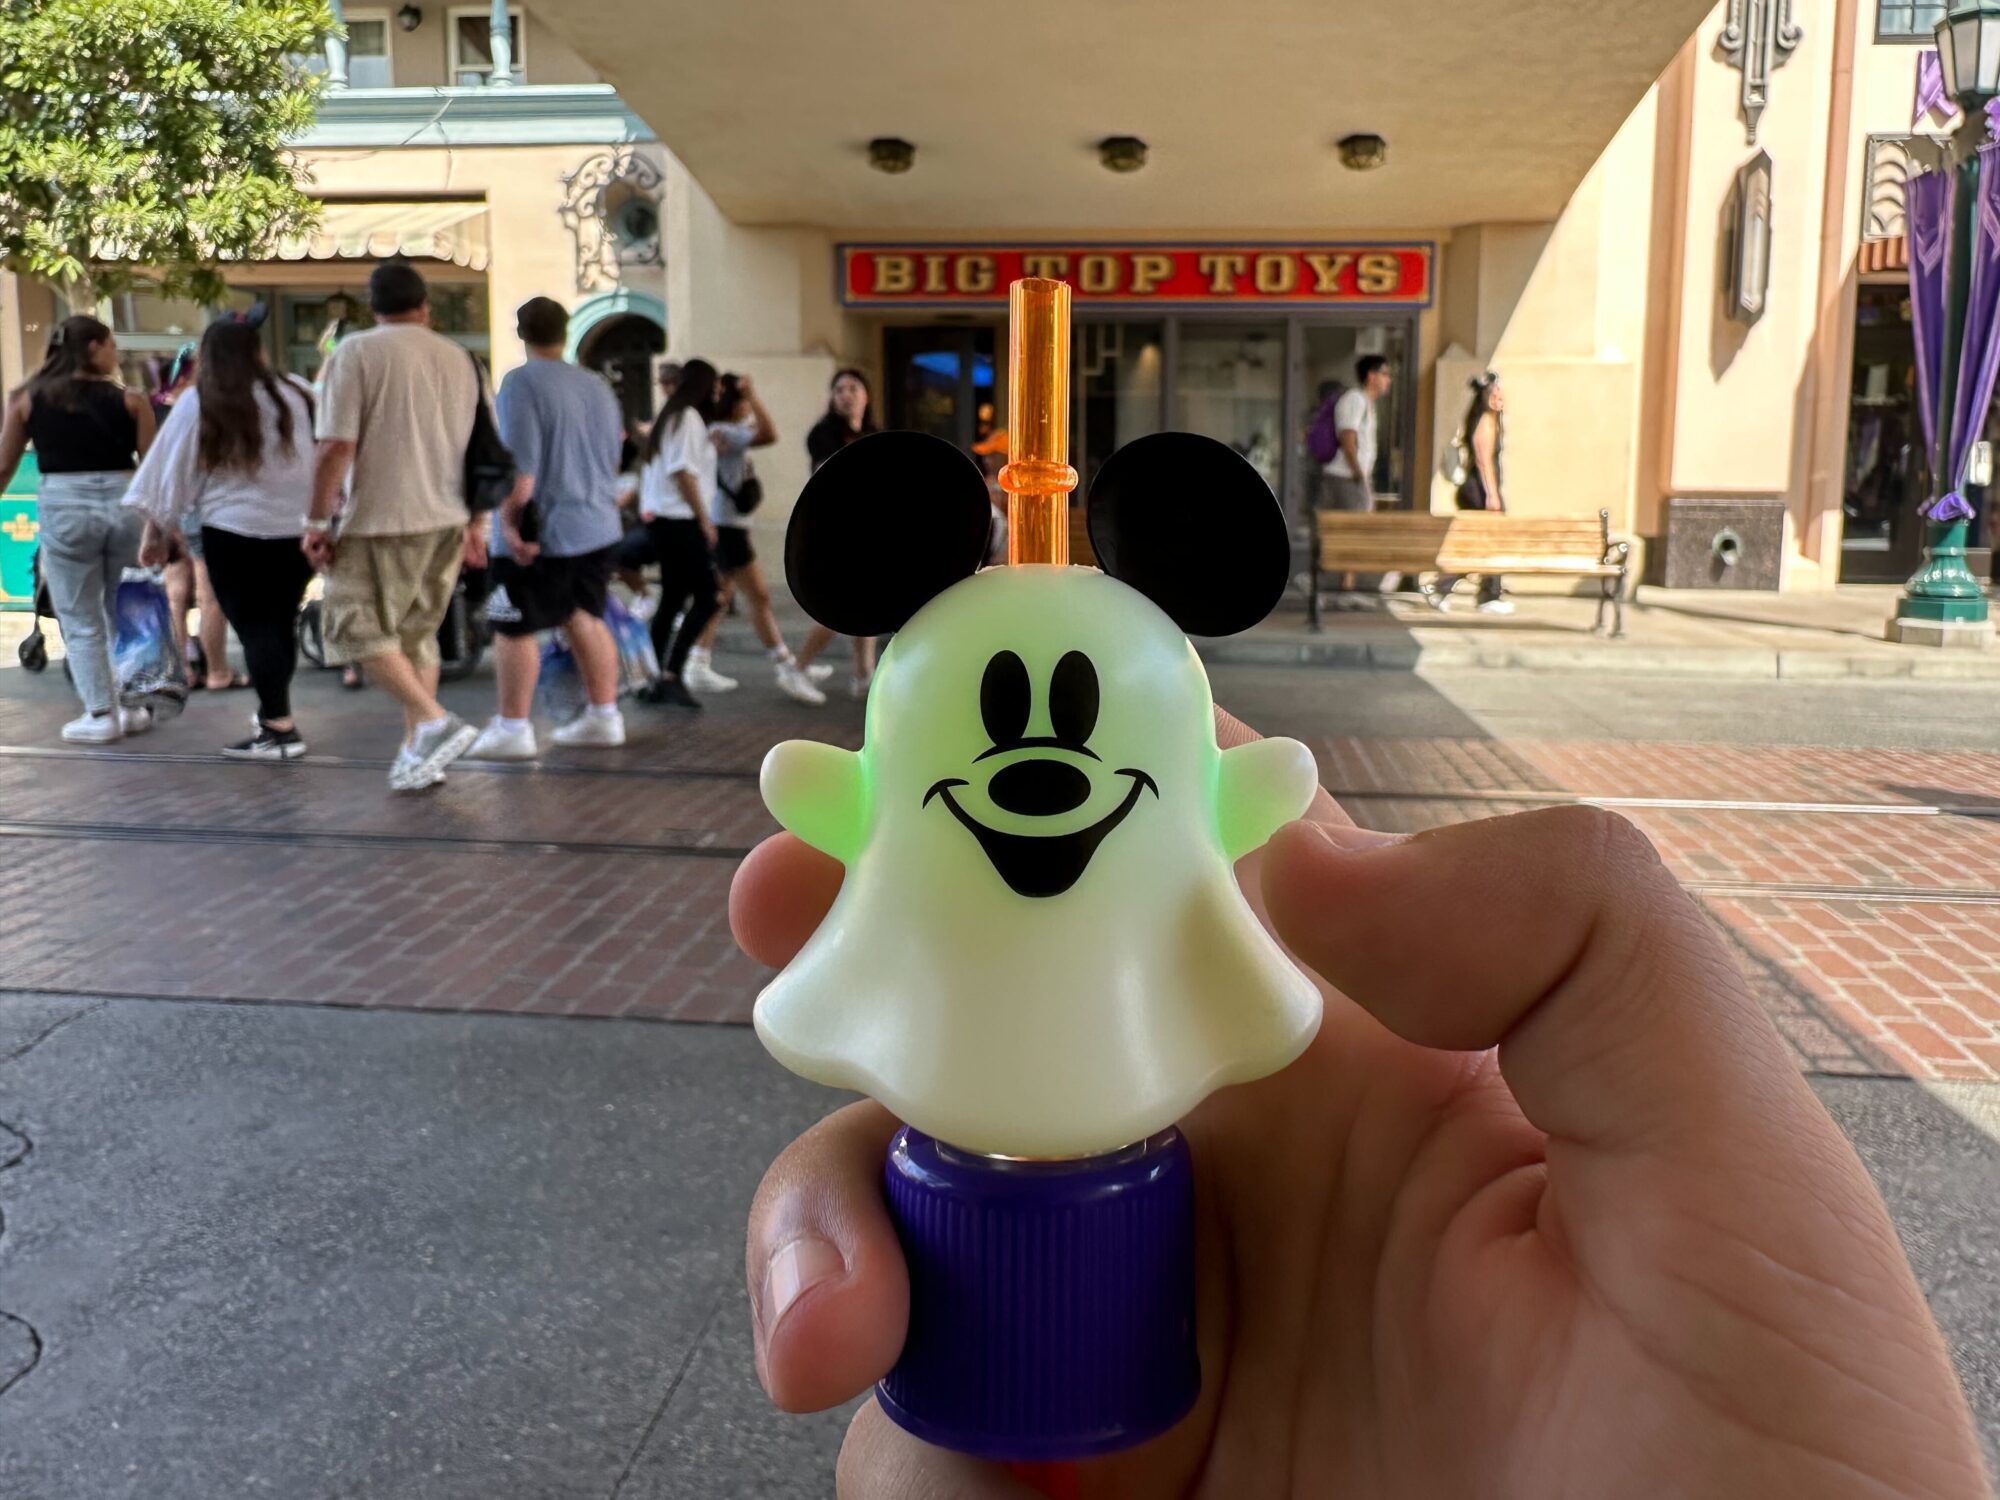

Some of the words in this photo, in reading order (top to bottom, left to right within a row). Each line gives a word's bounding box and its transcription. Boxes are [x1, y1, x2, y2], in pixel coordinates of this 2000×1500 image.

[873, 254, 995, 293] BIG
[1023, 254, 1174, 293] TOP
[1200, 254, 1399, 293] TOYS
